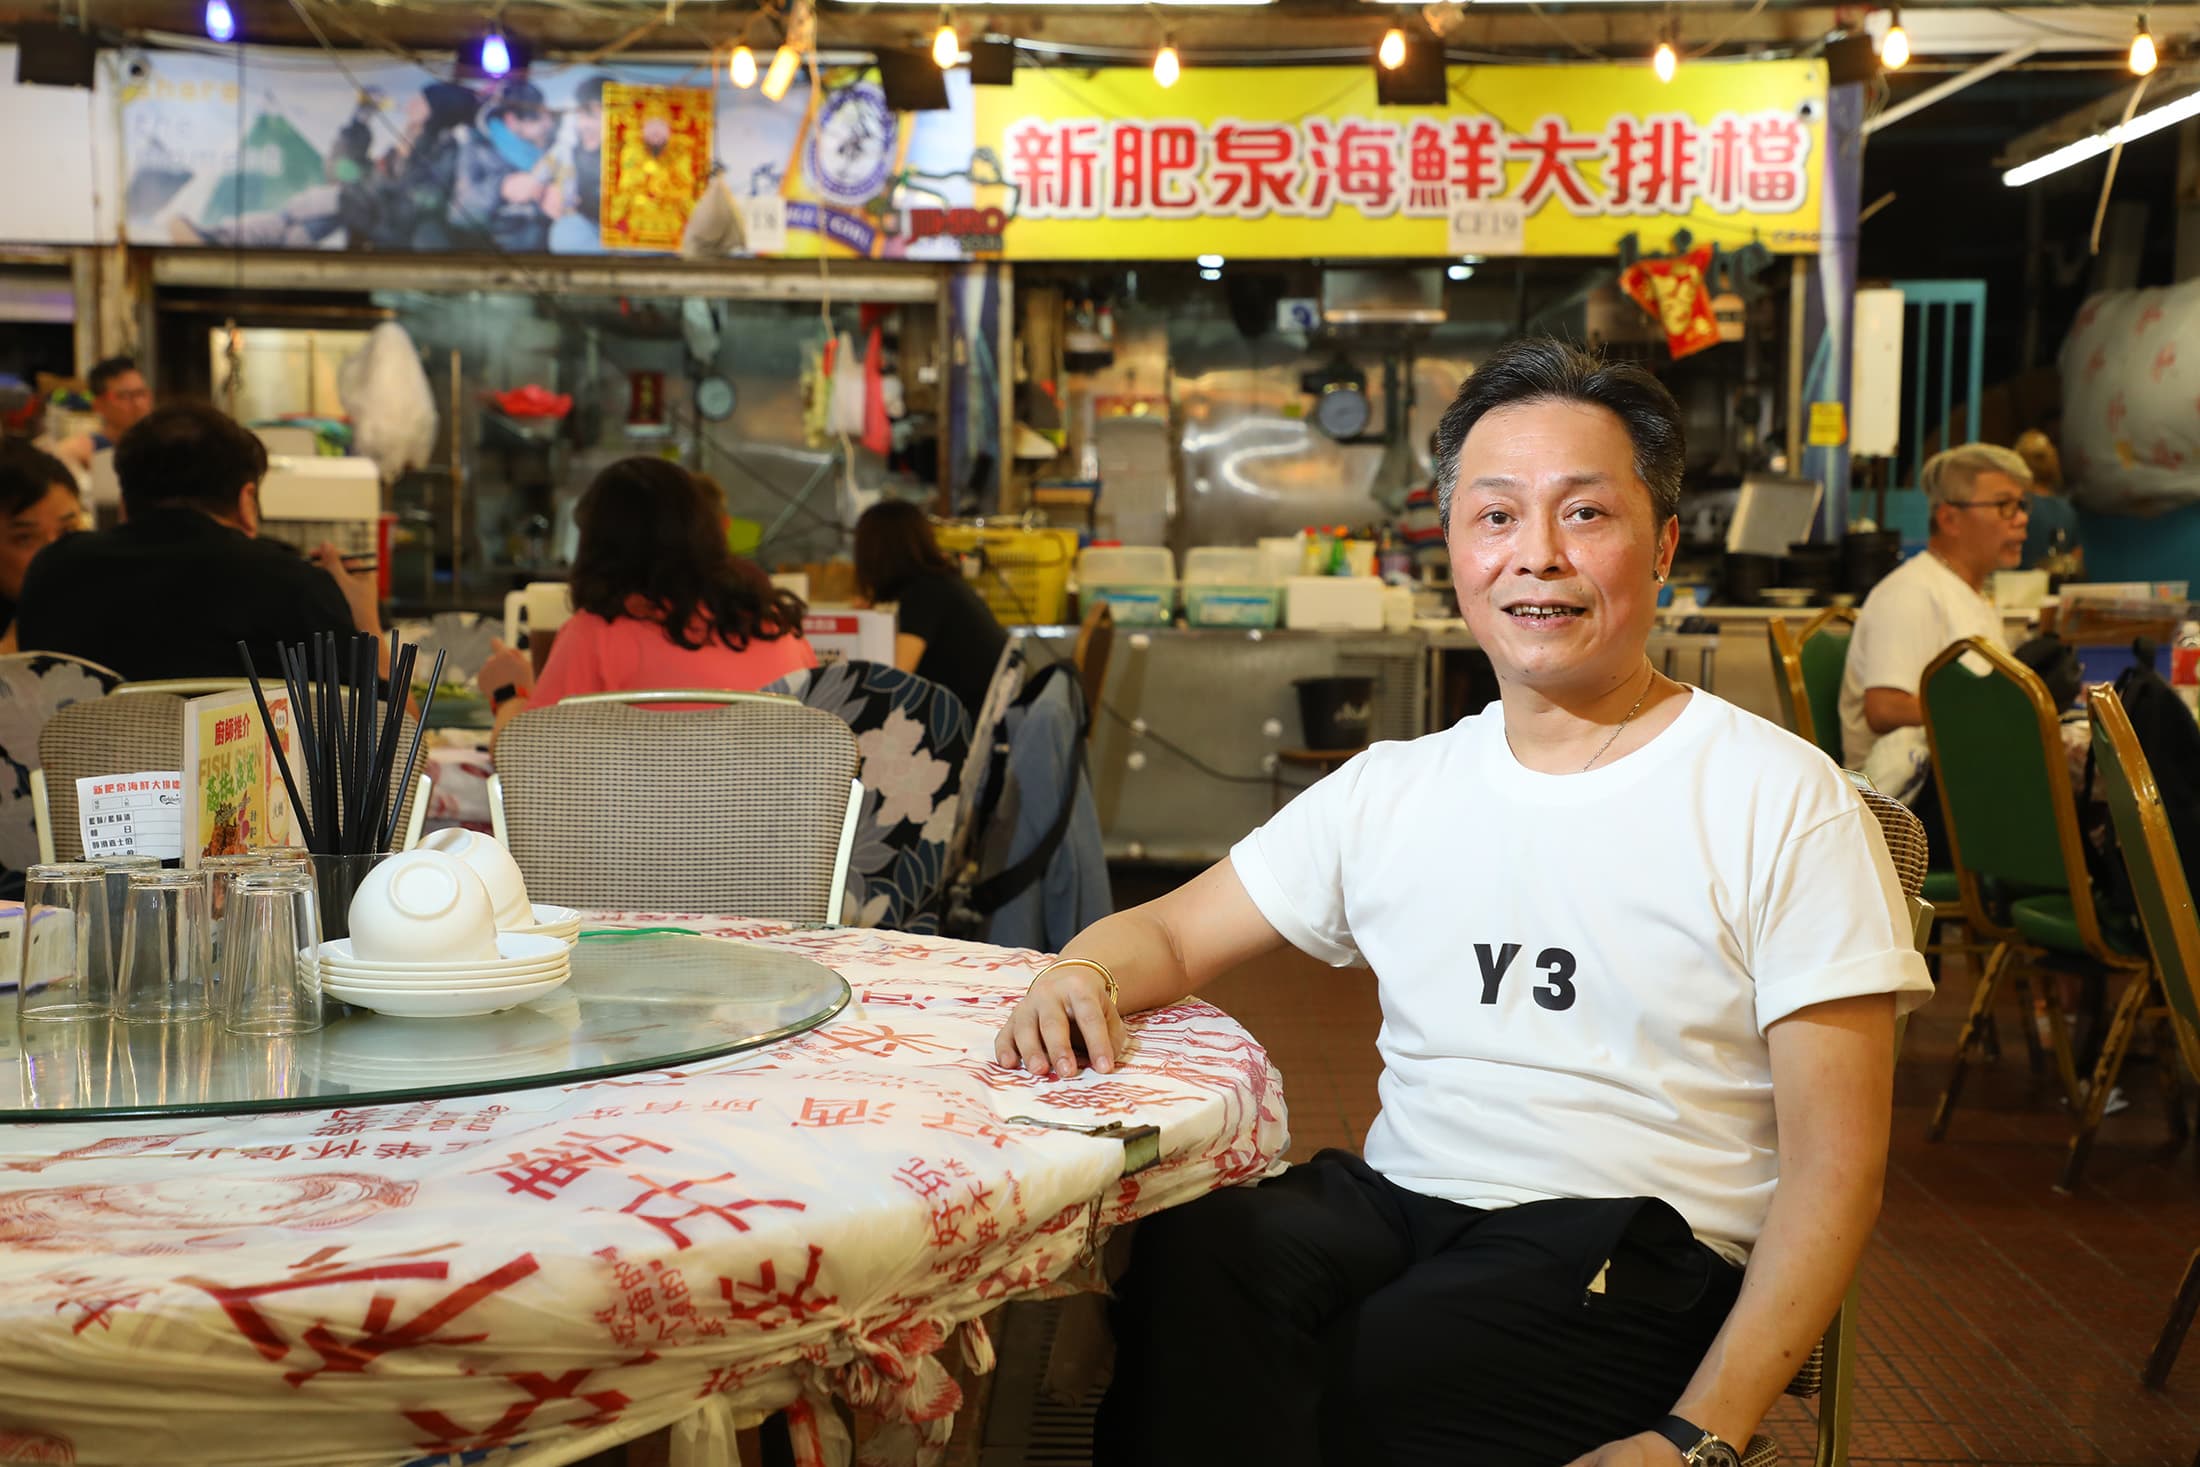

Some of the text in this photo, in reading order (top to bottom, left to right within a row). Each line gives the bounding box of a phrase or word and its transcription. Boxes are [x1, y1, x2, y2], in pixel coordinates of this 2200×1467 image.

[1009, 117, 1805, 211] 新肥泉海鮮大排檔
[199, 751, 231, 785] FISH
